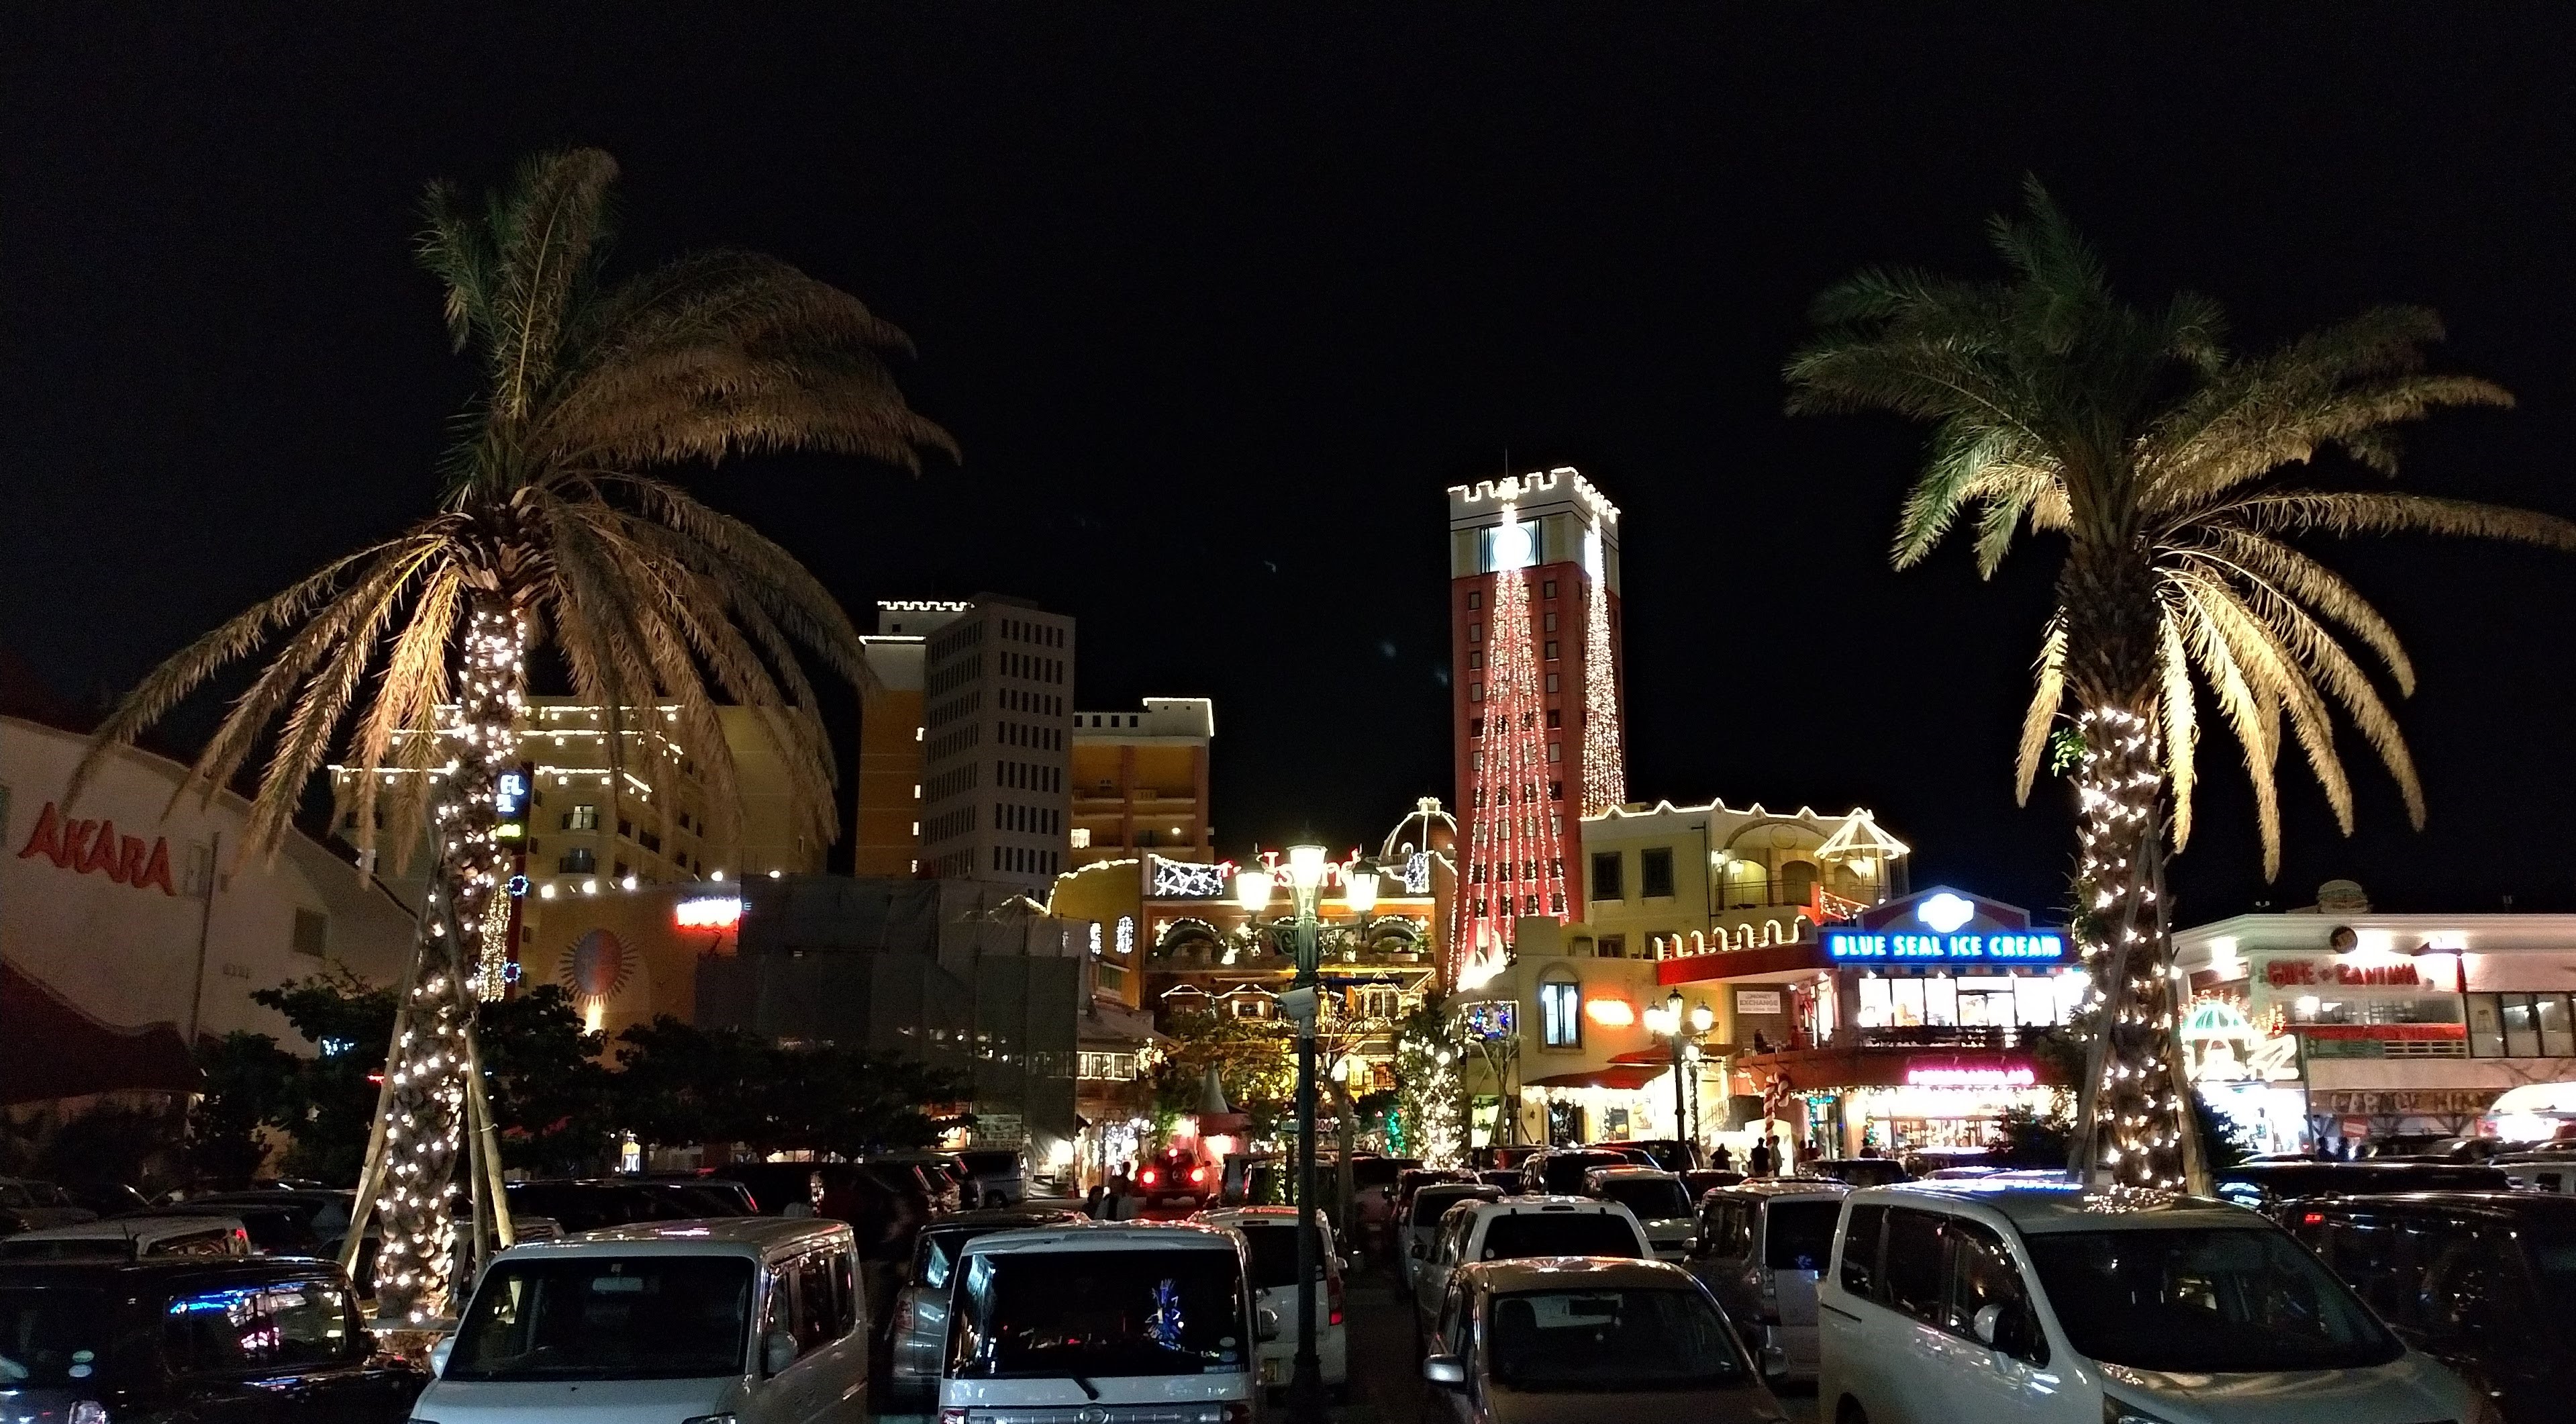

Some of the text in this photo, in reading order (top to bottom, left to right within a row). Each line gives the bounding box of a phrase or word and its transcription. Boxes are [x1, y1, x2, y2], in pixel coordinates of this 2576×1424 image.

[16, 801, 177, 897] AKARA
[1833, 935, 2063, 957] BLUE SEAL ICE CREAM
